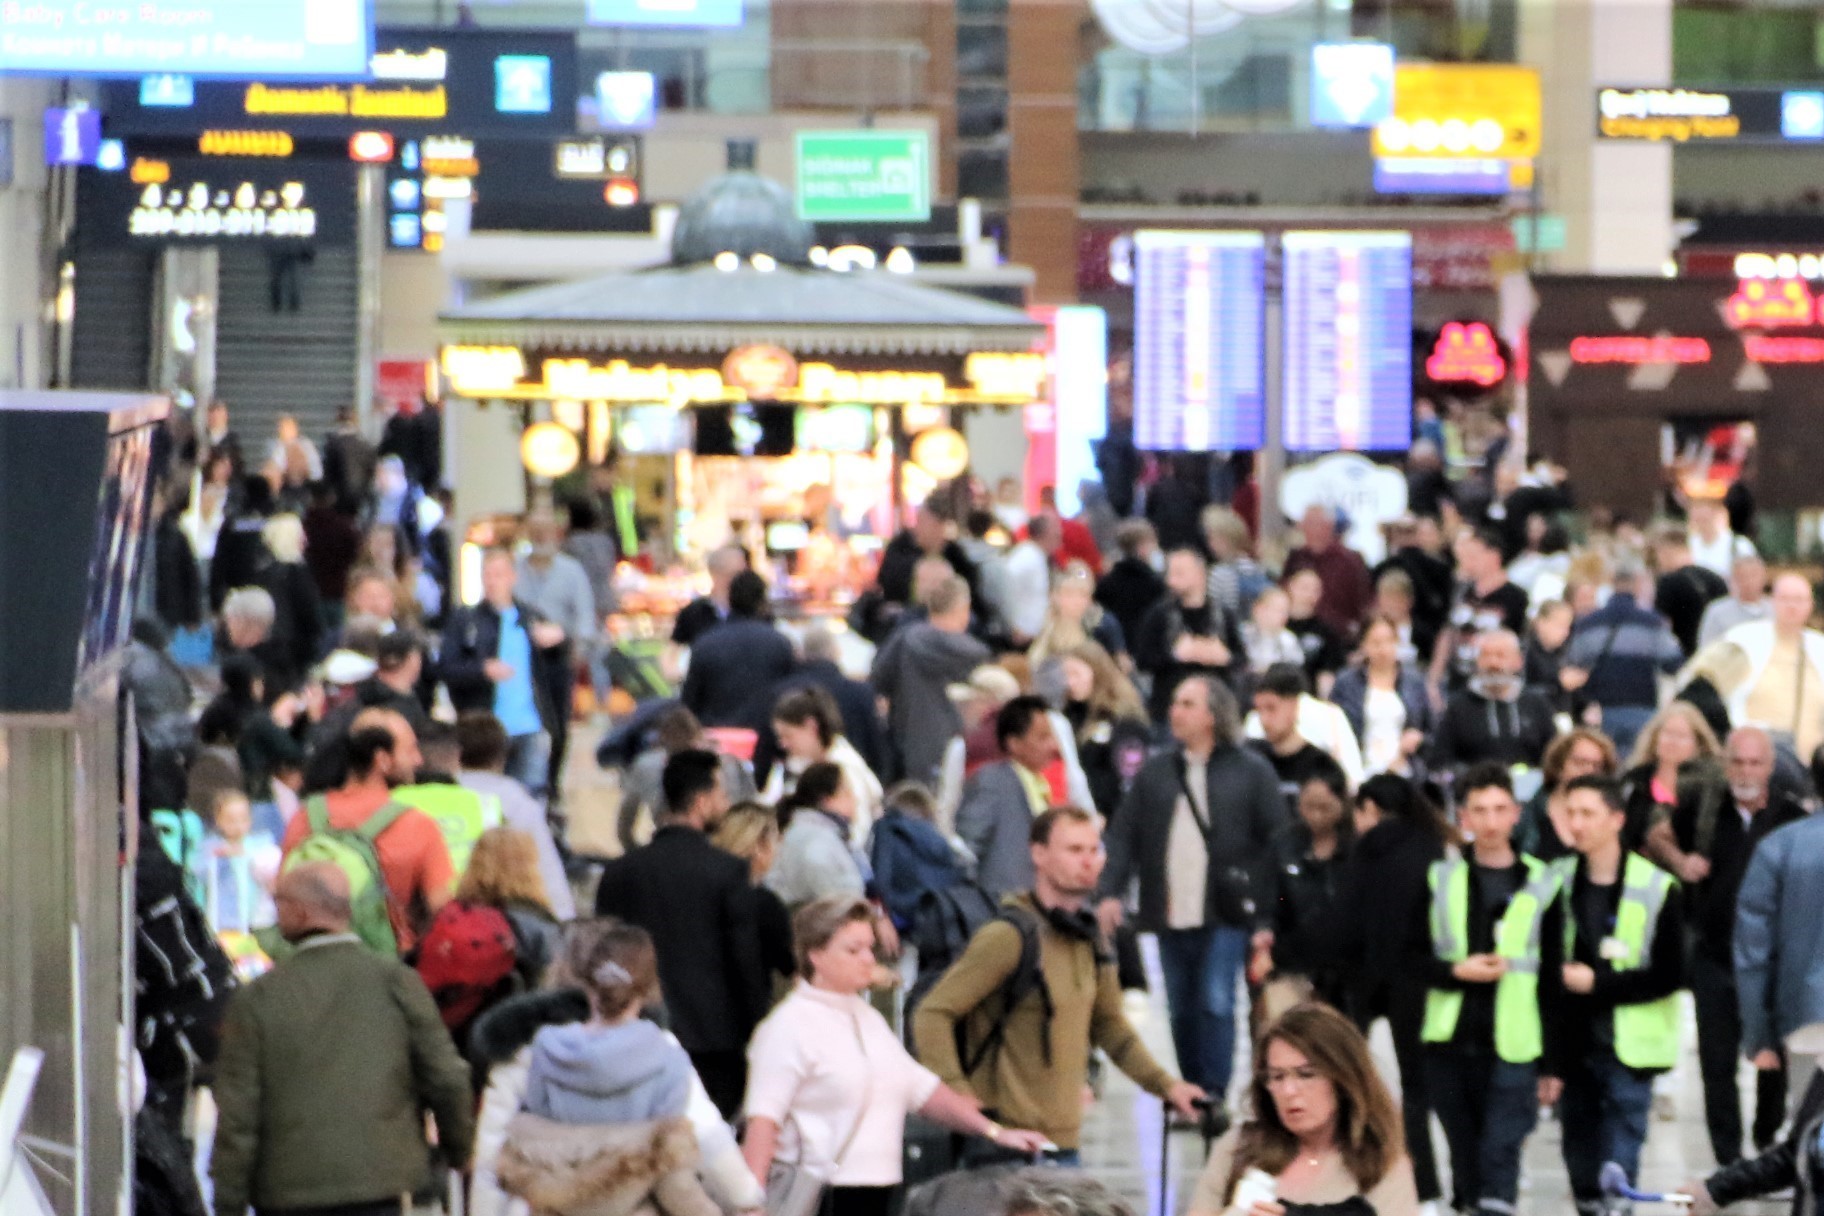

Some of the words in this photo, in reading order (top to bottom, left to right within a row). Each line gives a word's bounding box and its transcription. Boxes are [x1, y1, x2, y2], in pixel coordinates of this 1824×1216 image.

[3, 2, 64, 29] Baby
[74, 3, 130, 24] Care
[140, 4, 212, 25] Room
